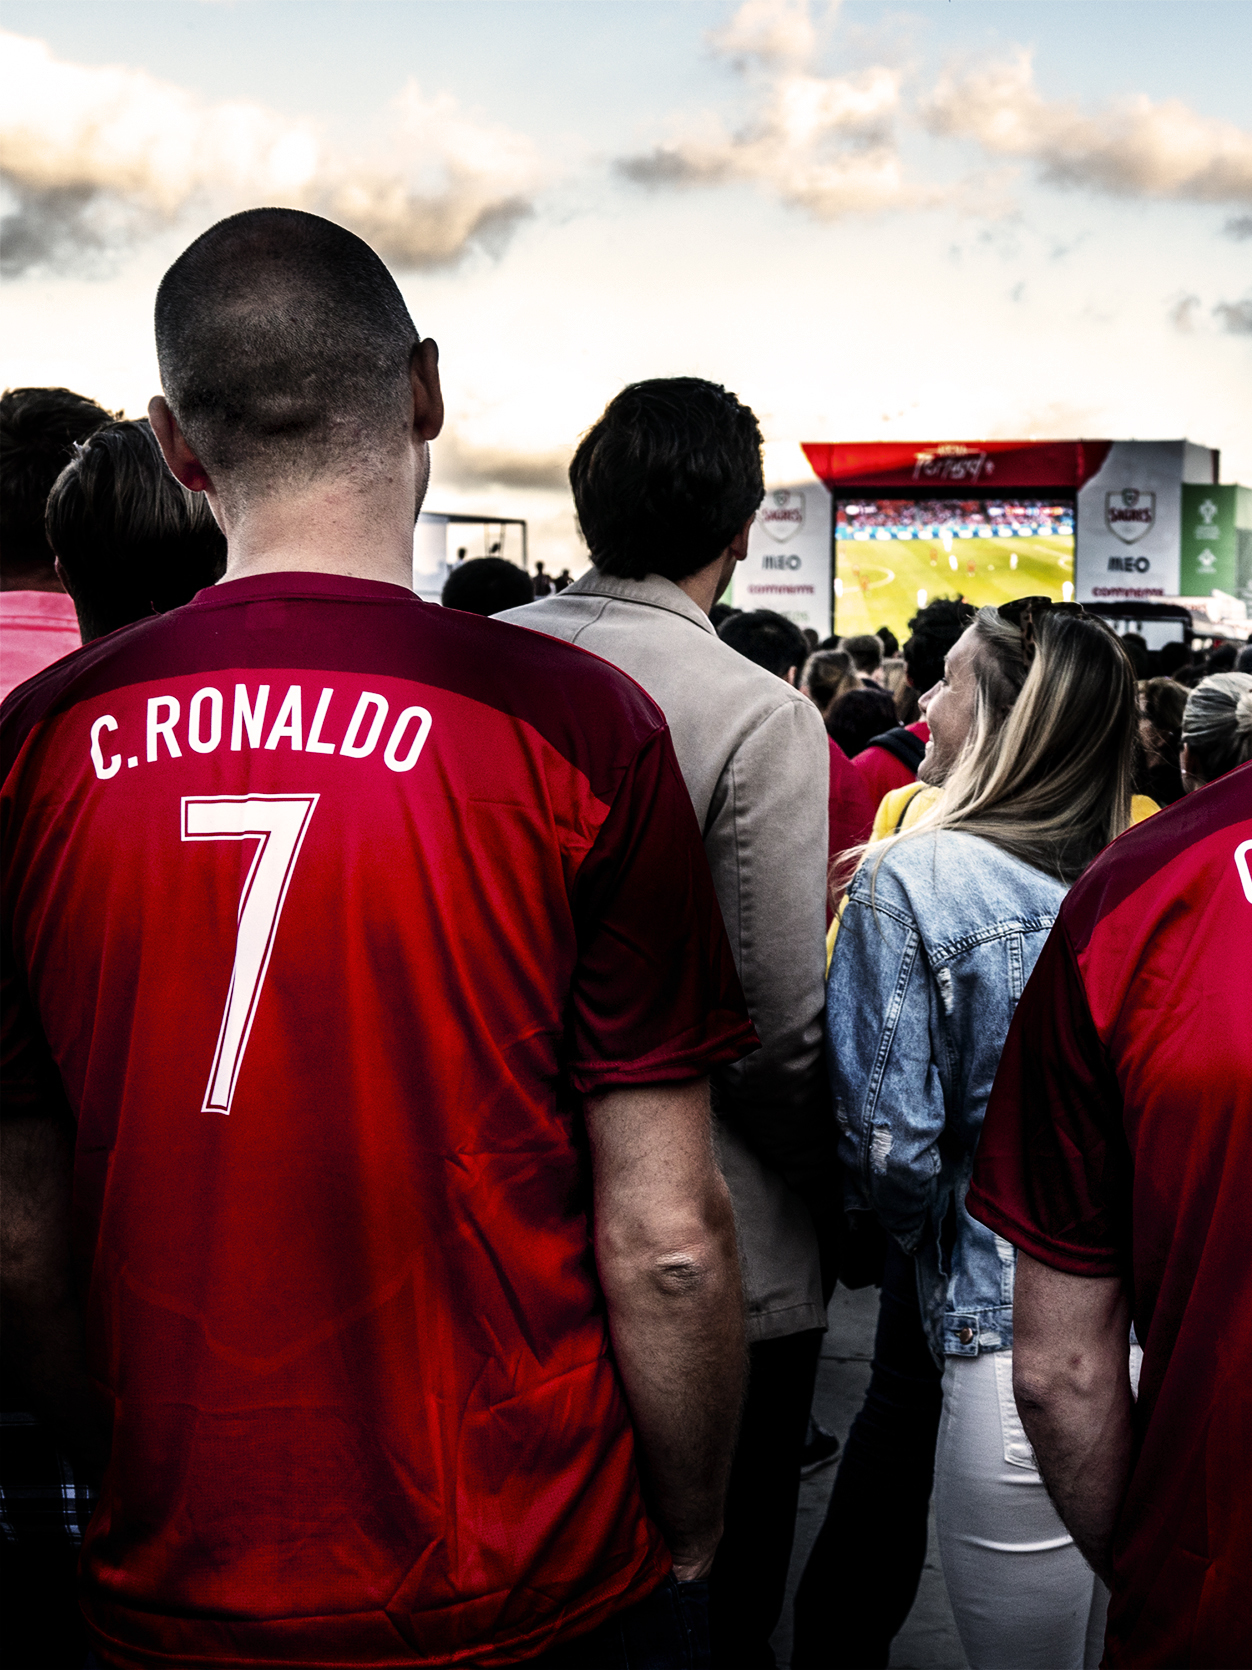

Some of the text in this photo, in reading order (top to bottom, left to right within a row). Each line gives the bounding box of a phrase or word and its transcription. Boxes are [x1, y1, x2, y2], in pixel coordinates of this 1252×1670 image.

[1107, 556, 1151, 573] MEO
[90, 683, 433, 780] C.RONALDO
[180, 792, 321, 1116] 7
